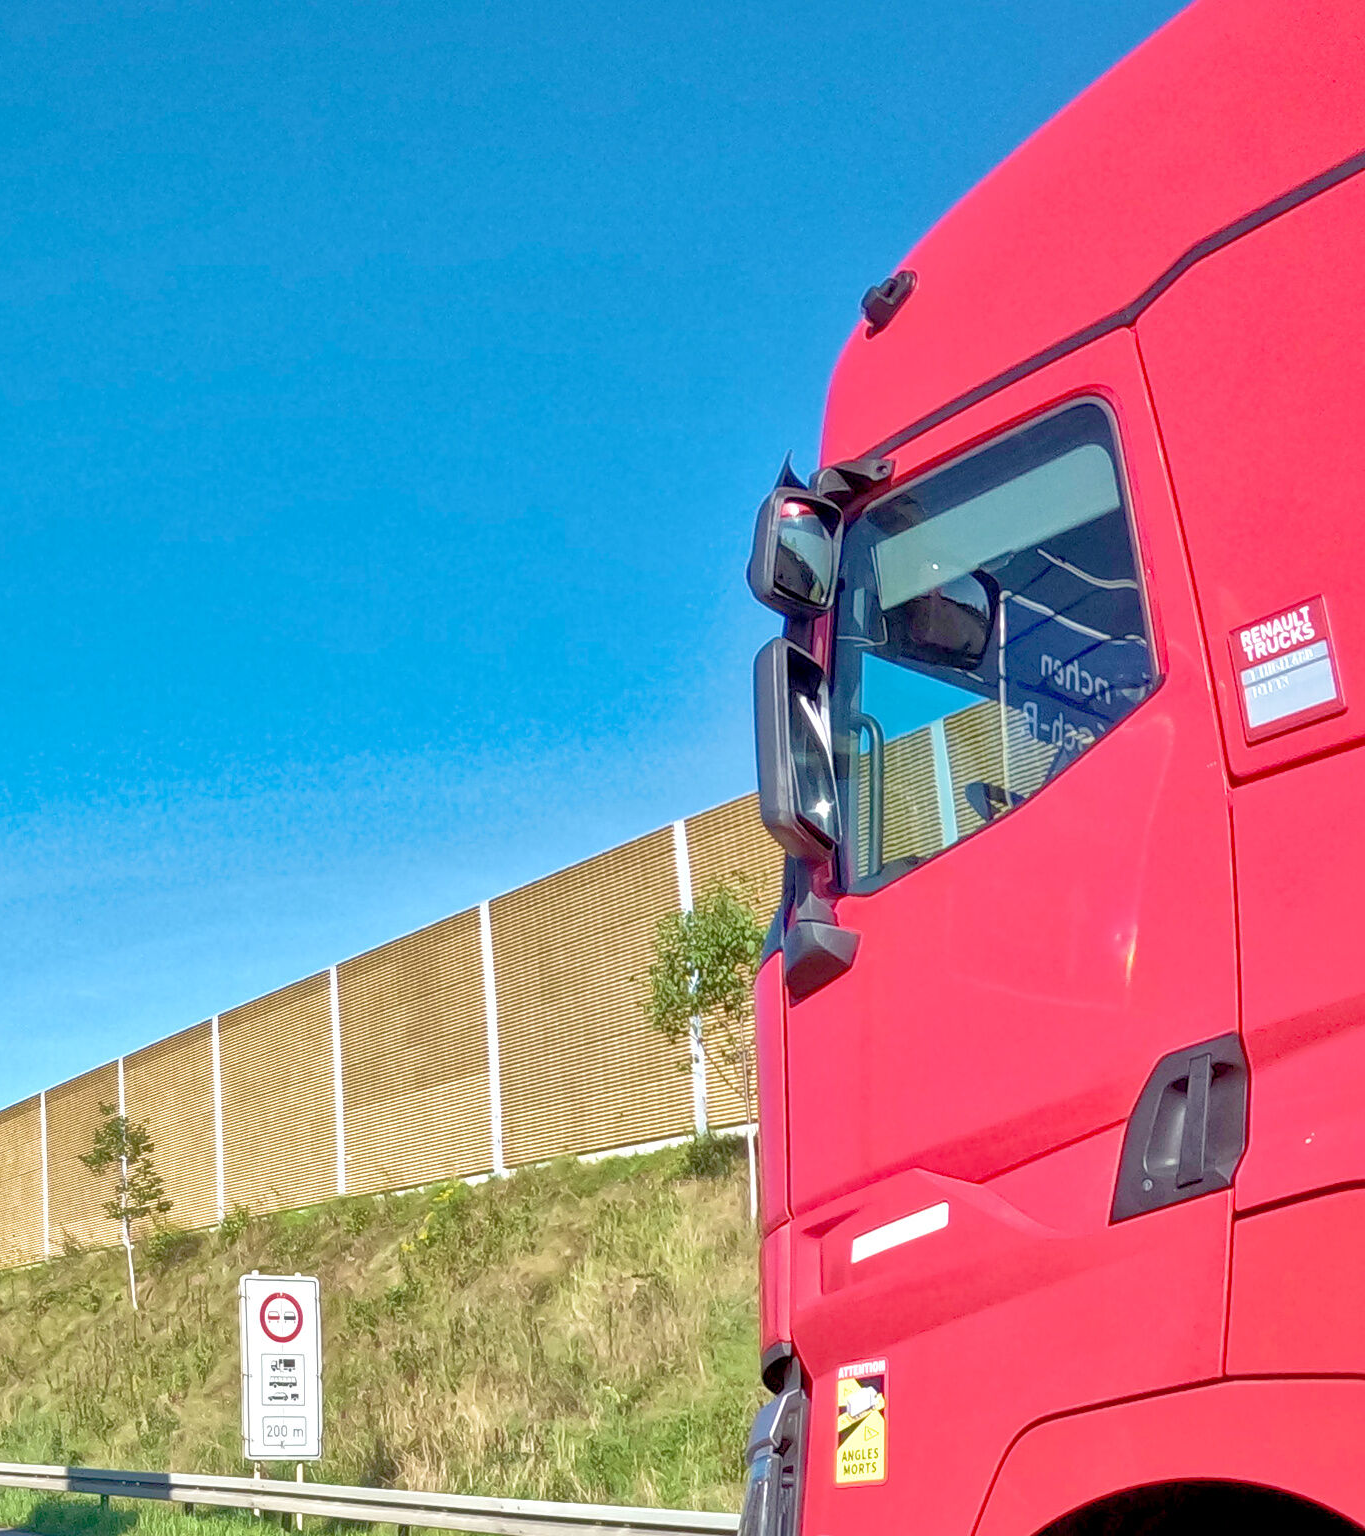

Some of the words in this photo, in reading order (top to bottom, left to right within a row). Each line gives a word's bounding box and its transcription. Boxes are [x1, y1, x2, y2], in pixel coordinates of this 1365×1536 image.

[1240, 606, 1310, 648] RENAULT
[1243, 622, 1316, 662] TRUCKS
[838, 1360, 886, 1379] ATTENTION
[266, 1425, 288, 1438] 200
[292, 1428, 304, 1437] m
[842, 1447, 879, 1462] ANGLES
[843, 1461, 877, 1475] MORTS
